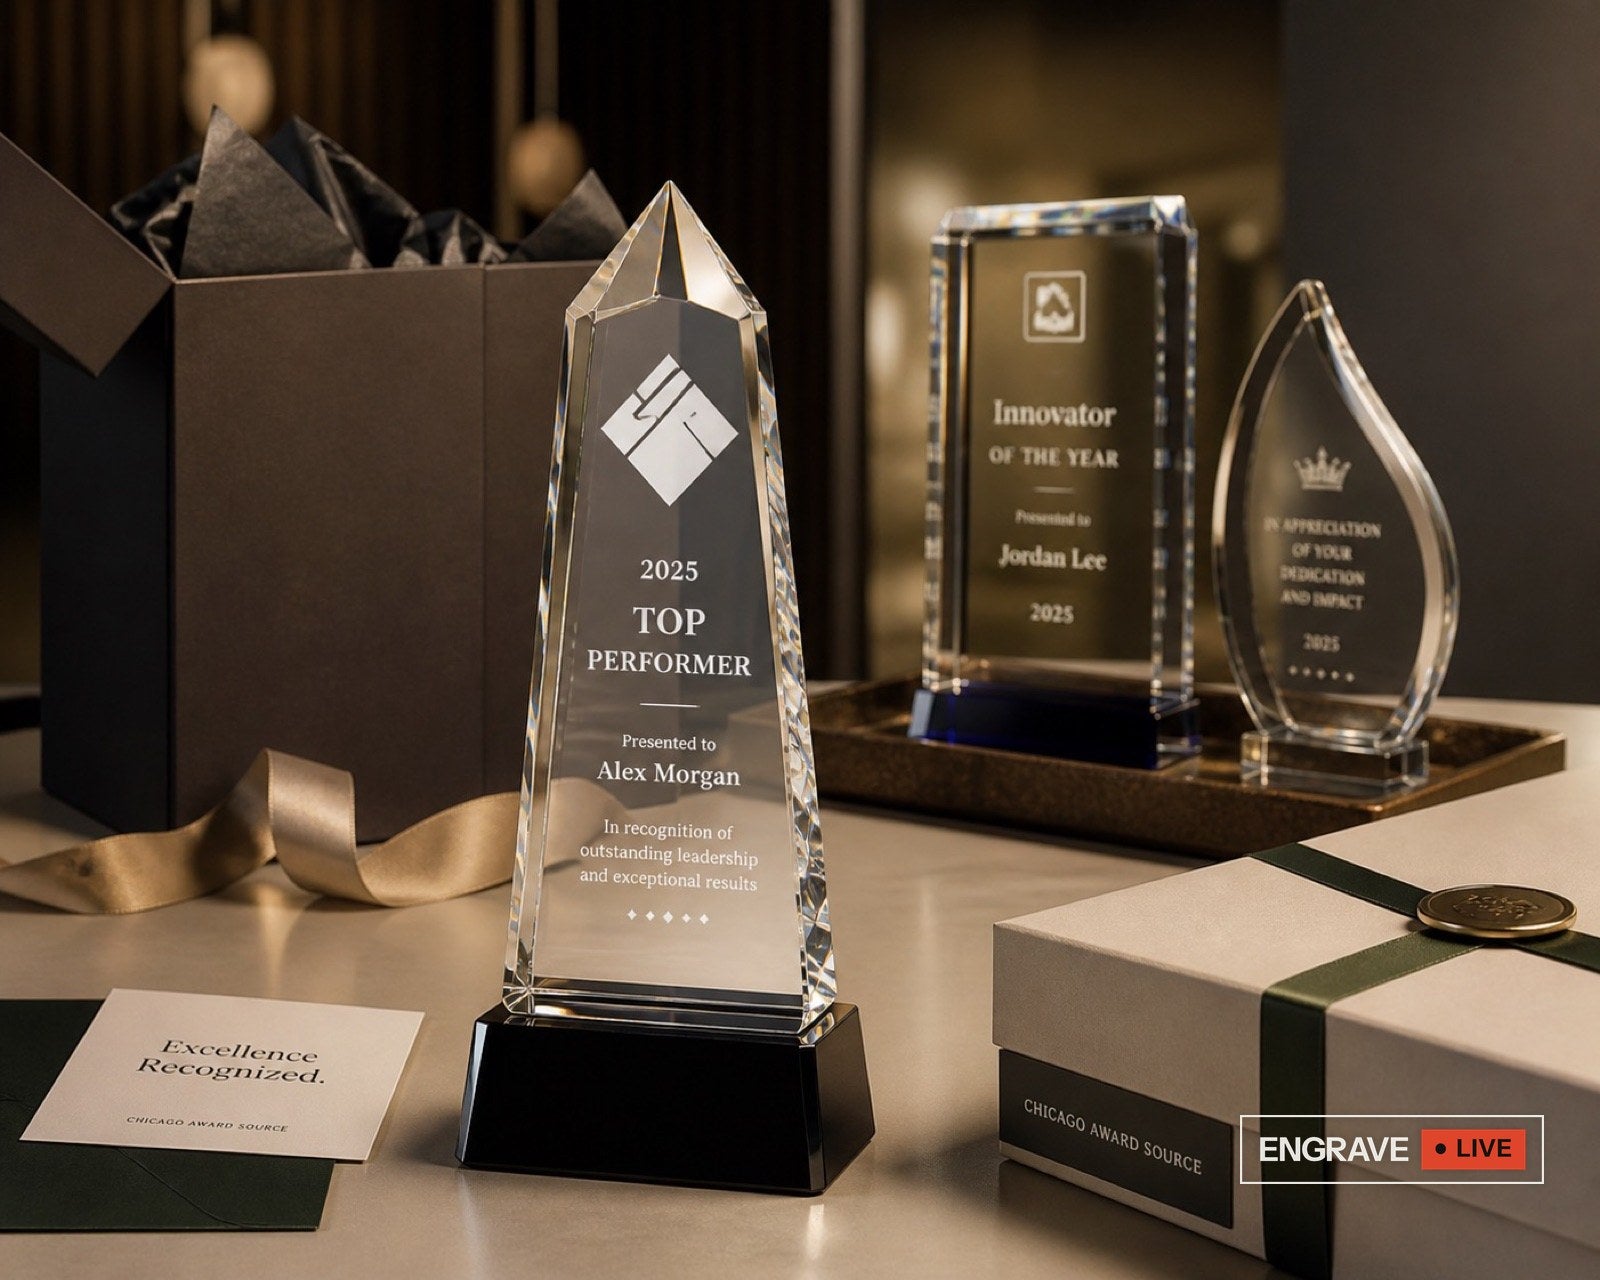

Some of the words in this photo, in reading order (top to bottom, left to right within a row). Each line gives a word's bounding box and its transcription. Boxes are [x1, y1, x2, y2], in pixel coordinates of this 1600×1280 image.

[993, 399, 1118, 427] Innovator
[988, 446, 1015, 465] OF
[1020, 447, 1060, 467] THE
[1066, 449, 1119, 468] YEAR
[1284, 517, 1382, 538] APPRECIATION
[998, 544, 1067, 568] Jordan
[1071, 547, 1108, 571] Lee
[640, 559, 699, 582] 2025
[633, 606, 706, 636] TOP
[1030, 602, 1075, 625] 2025
[587, 649, 752, 676] PERFORMER
[622, 734, 697, 751] Presented
[700, 737, 717, 752] to
[596, 760, 647, 782] Alex
[653, 763, 741, 790] Morgan
[603, 819, 619, 834] In
[624, 823, 712, 840] recognition
[717, 825, 734, 840] of
[579, 845, 673, 866] outstanding
[677, 847, 759, 870] leadership
[579, 868, 608, 882] and
[613, 871, 701, 889] exceptional
[705, 876, 758, 891] results
[161, 1039, 318, 1063] Excellence
[136, 1057, 326, 1084] Recognized.
[126, 1116, 184, 1127] CHICAGO
[188, 1120, 234, 1130] AWARD
[238, 1123, 289, 1133] SOURCE
[1023, 1098, 1086, 1132] CHICAGO
[1090, 1122, 1140, 1151] AWARD
[1144, 1141, 1203, 1176] SOURCE
